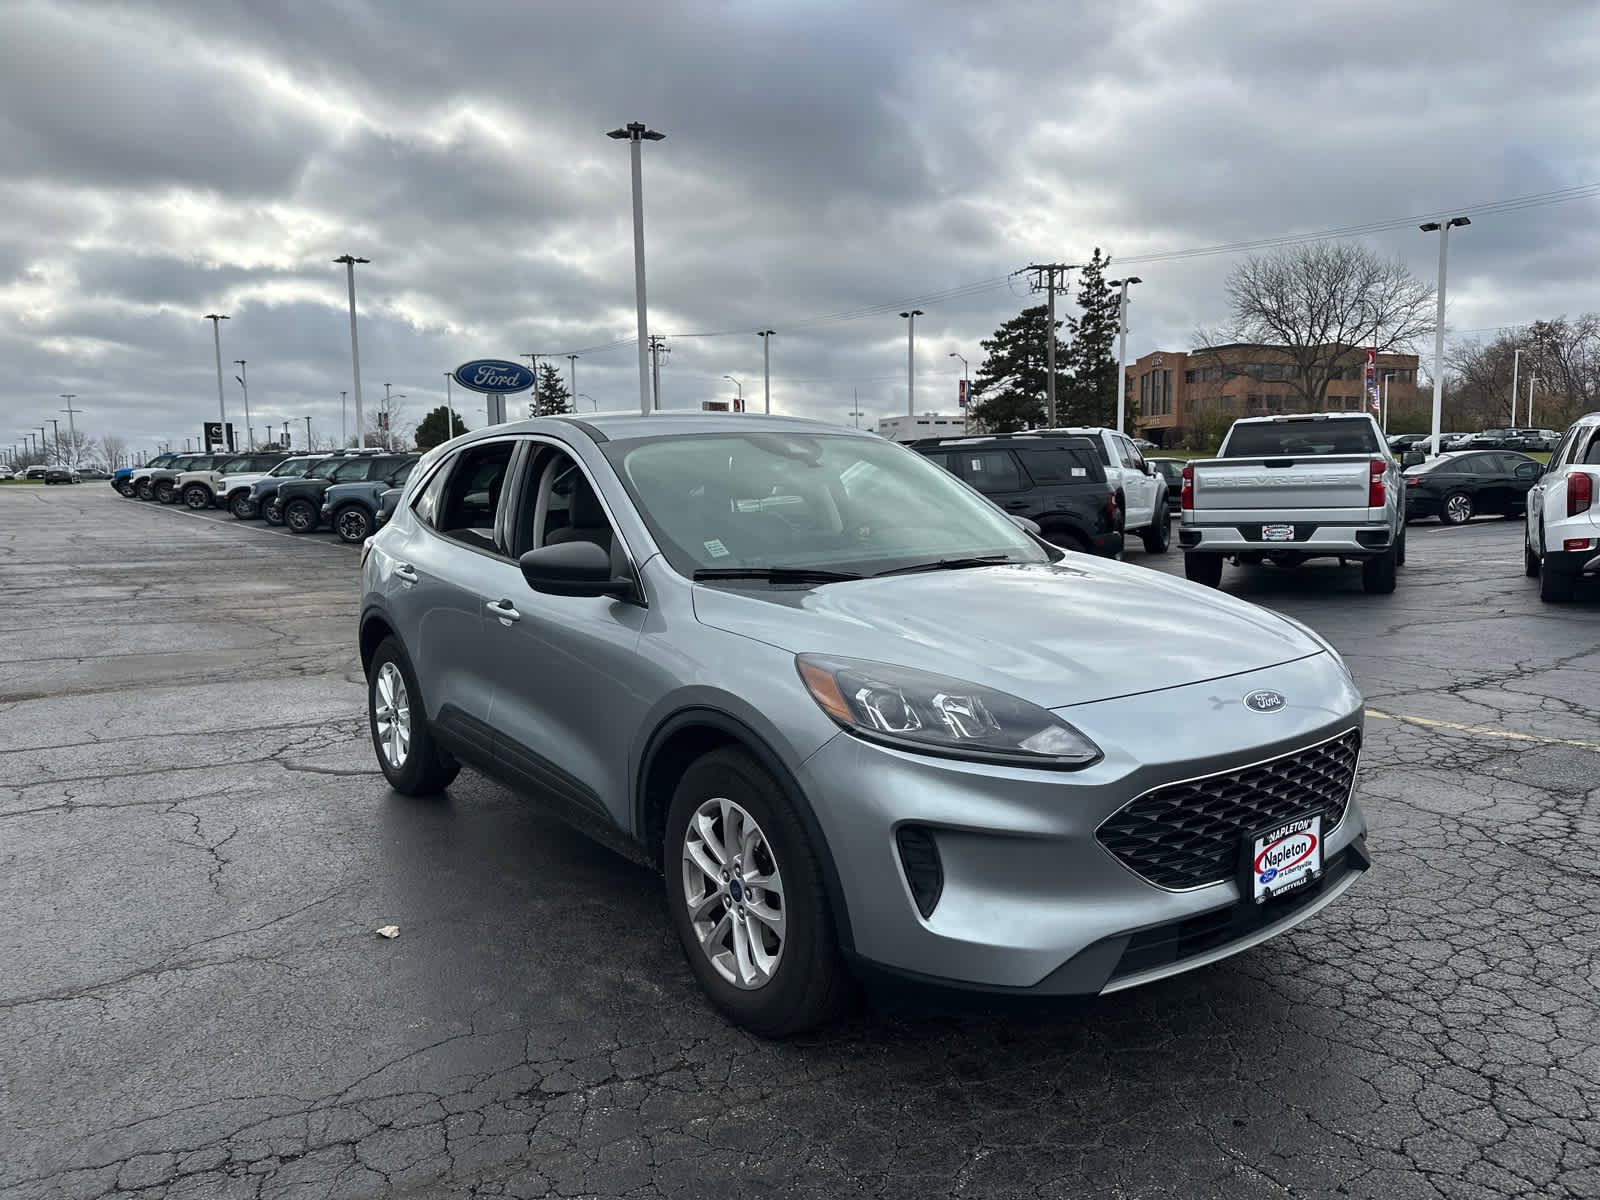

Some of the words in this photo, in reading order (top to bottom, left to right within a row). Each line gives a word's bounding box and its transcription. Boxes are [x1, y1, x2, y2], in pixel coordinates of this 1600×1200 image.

[474, 365, 520, 387] Ford
[1203, 474, 1357, 488] CHEVROLET
[1255, 693, 1281, 709] Ford
[1264, 842, 1307, 870] Napleton
[1261, 869, 1276, 883] Ford
[1284, 860, 1312, 876] Libertyville
[1272, 877, 1307, 897] LIBERTYVILLE
